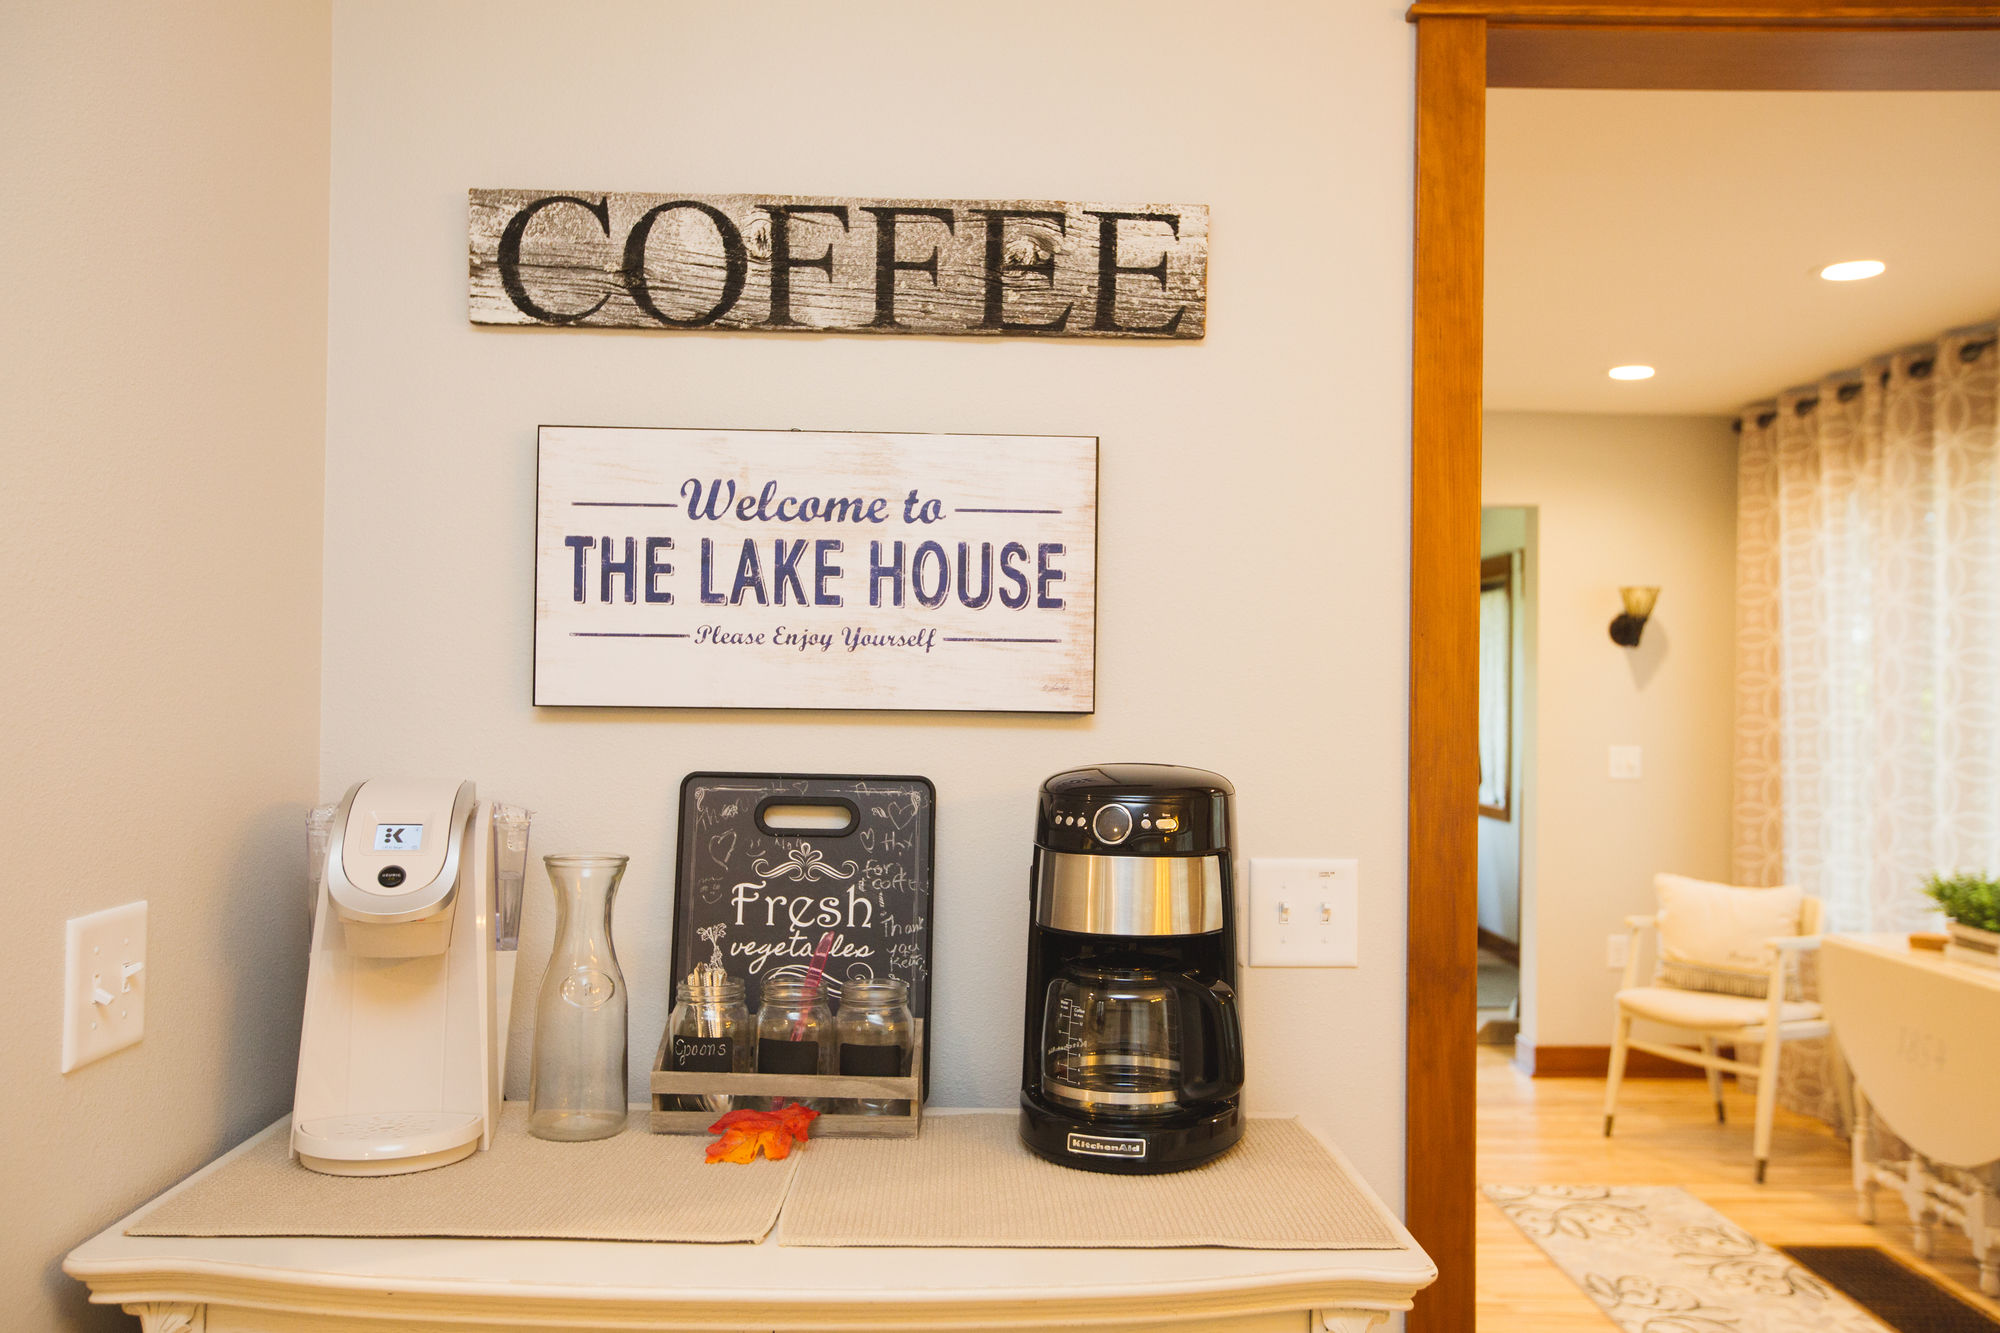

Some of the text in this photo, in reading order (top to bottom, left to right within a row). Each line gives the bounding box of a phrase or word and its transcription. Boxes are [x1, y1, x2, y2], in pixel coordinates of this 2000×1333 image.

[499, 195, 1185, 333] COFFEE
[680, 477, 947, 525] Welcome to
[564, 535, 1067, 611] THE LAKE HOUSE
[695, 625, 939, 654] Please Enjoy Yourself
[731, 880, 872, 932] Fresh
[675, 1038, 727, 1066] Spoons
[1072, 1139, 1140, 1152] KitchenAid
